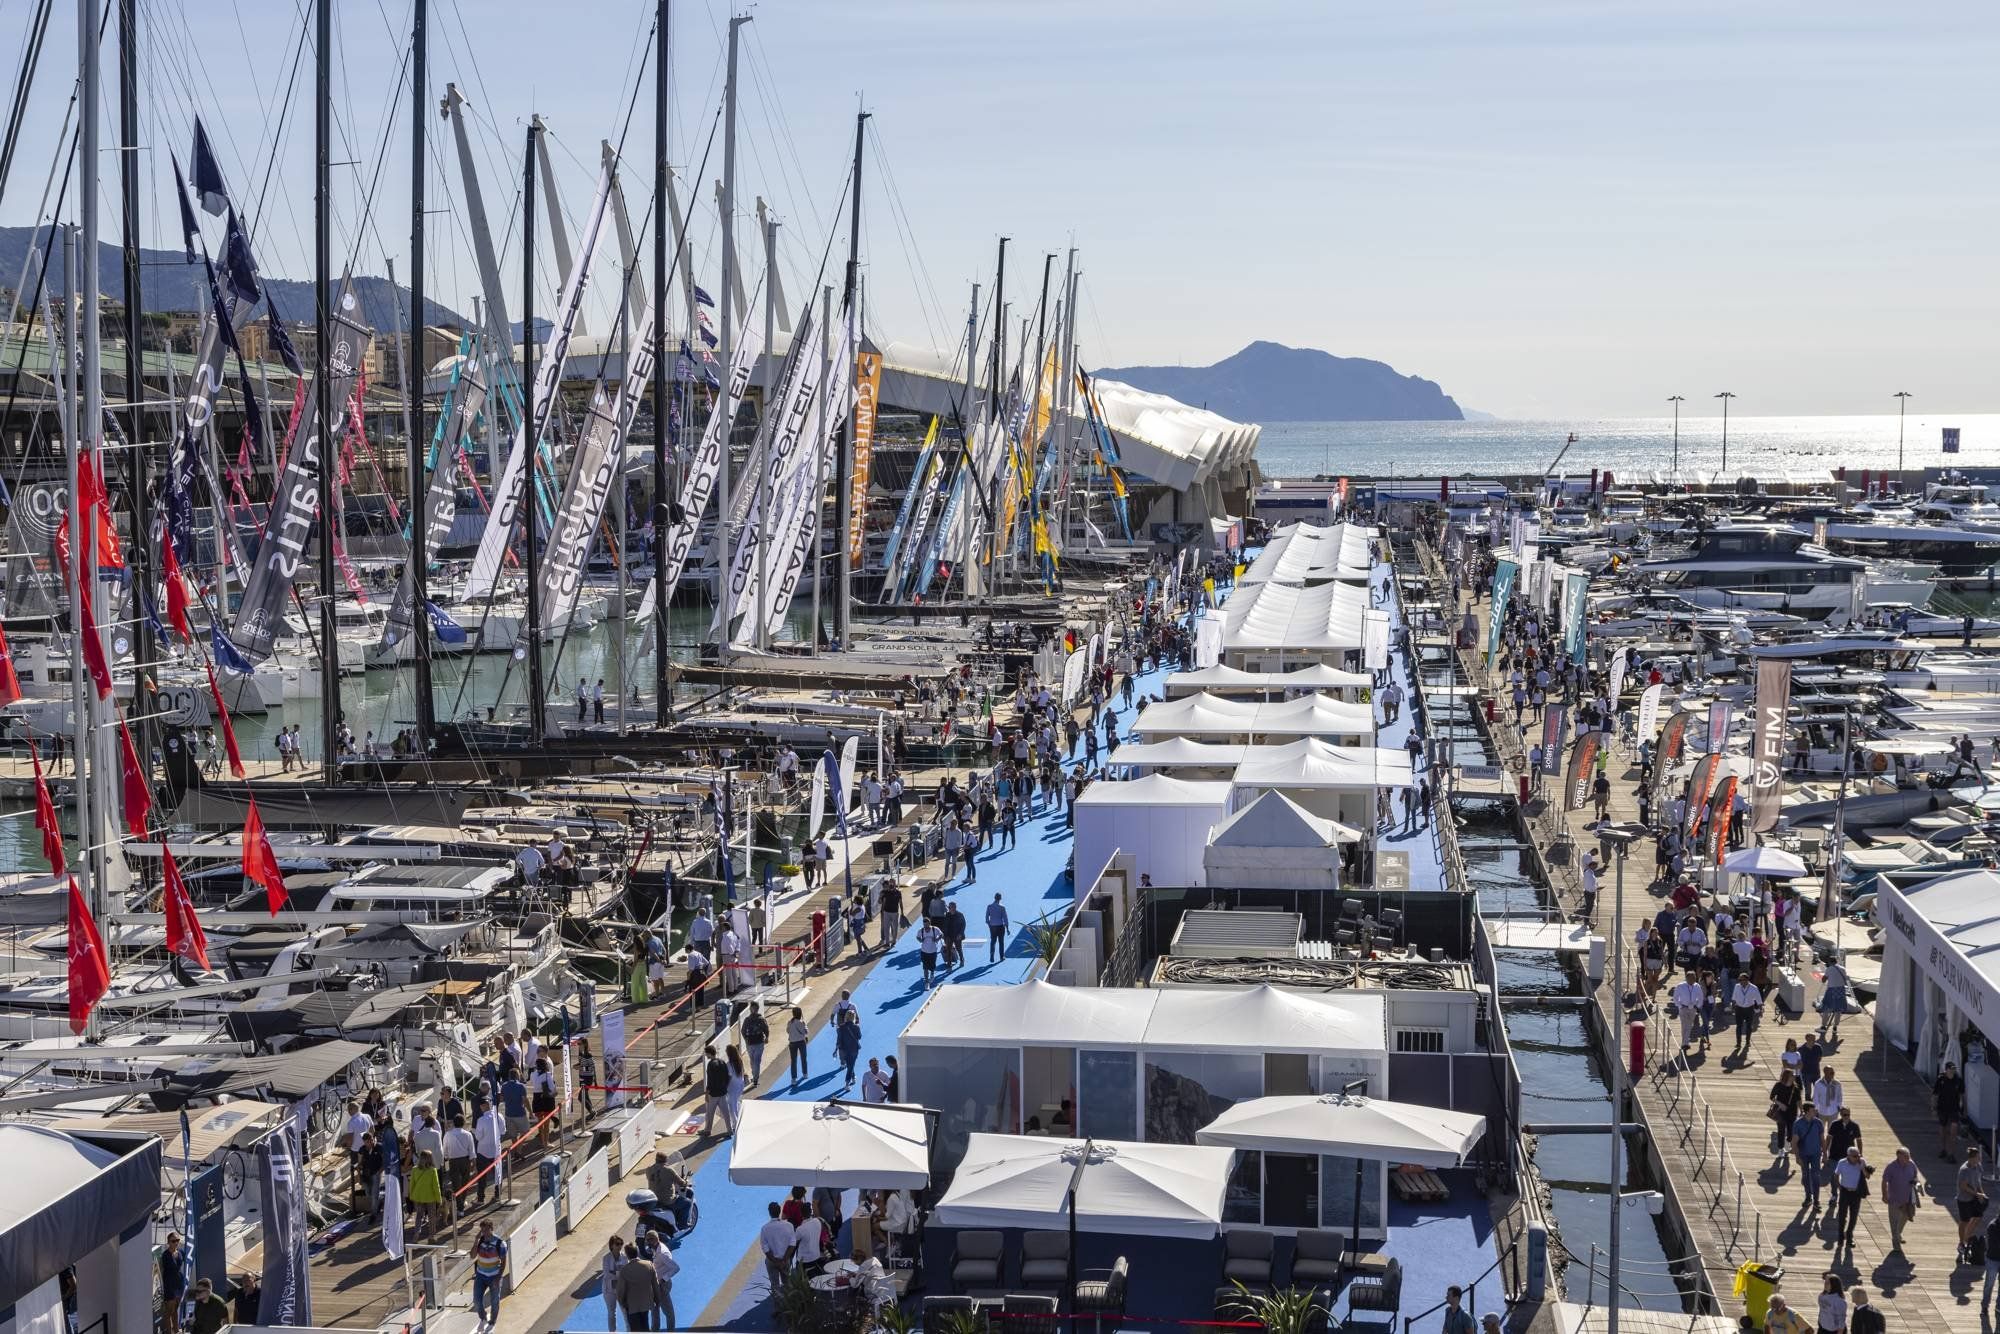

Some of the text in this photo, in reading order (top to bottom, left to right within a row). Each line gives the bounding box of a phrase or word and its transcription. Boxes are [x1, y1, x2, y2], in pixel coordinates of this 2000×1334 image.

[855, 382, 875, 470] CONTEST
[898, 477, 918, 524] DUFOUR
[934, 499, 957, 548] DUFOUR
[15, 573, 62, 583] CATAN
[1468, 548, 1478, 587] ASTONDOA
[867, 627, 900, 635] GRAND
[1765, 707, 1783, 758] FIM
[1545, 743, 1555, 769] solaris
[1687, 806, 1698, 828] solaris
[1709, 831, 1719, 854] solaris
[1328, 1071, 1377, 1079] JEANNEAU
